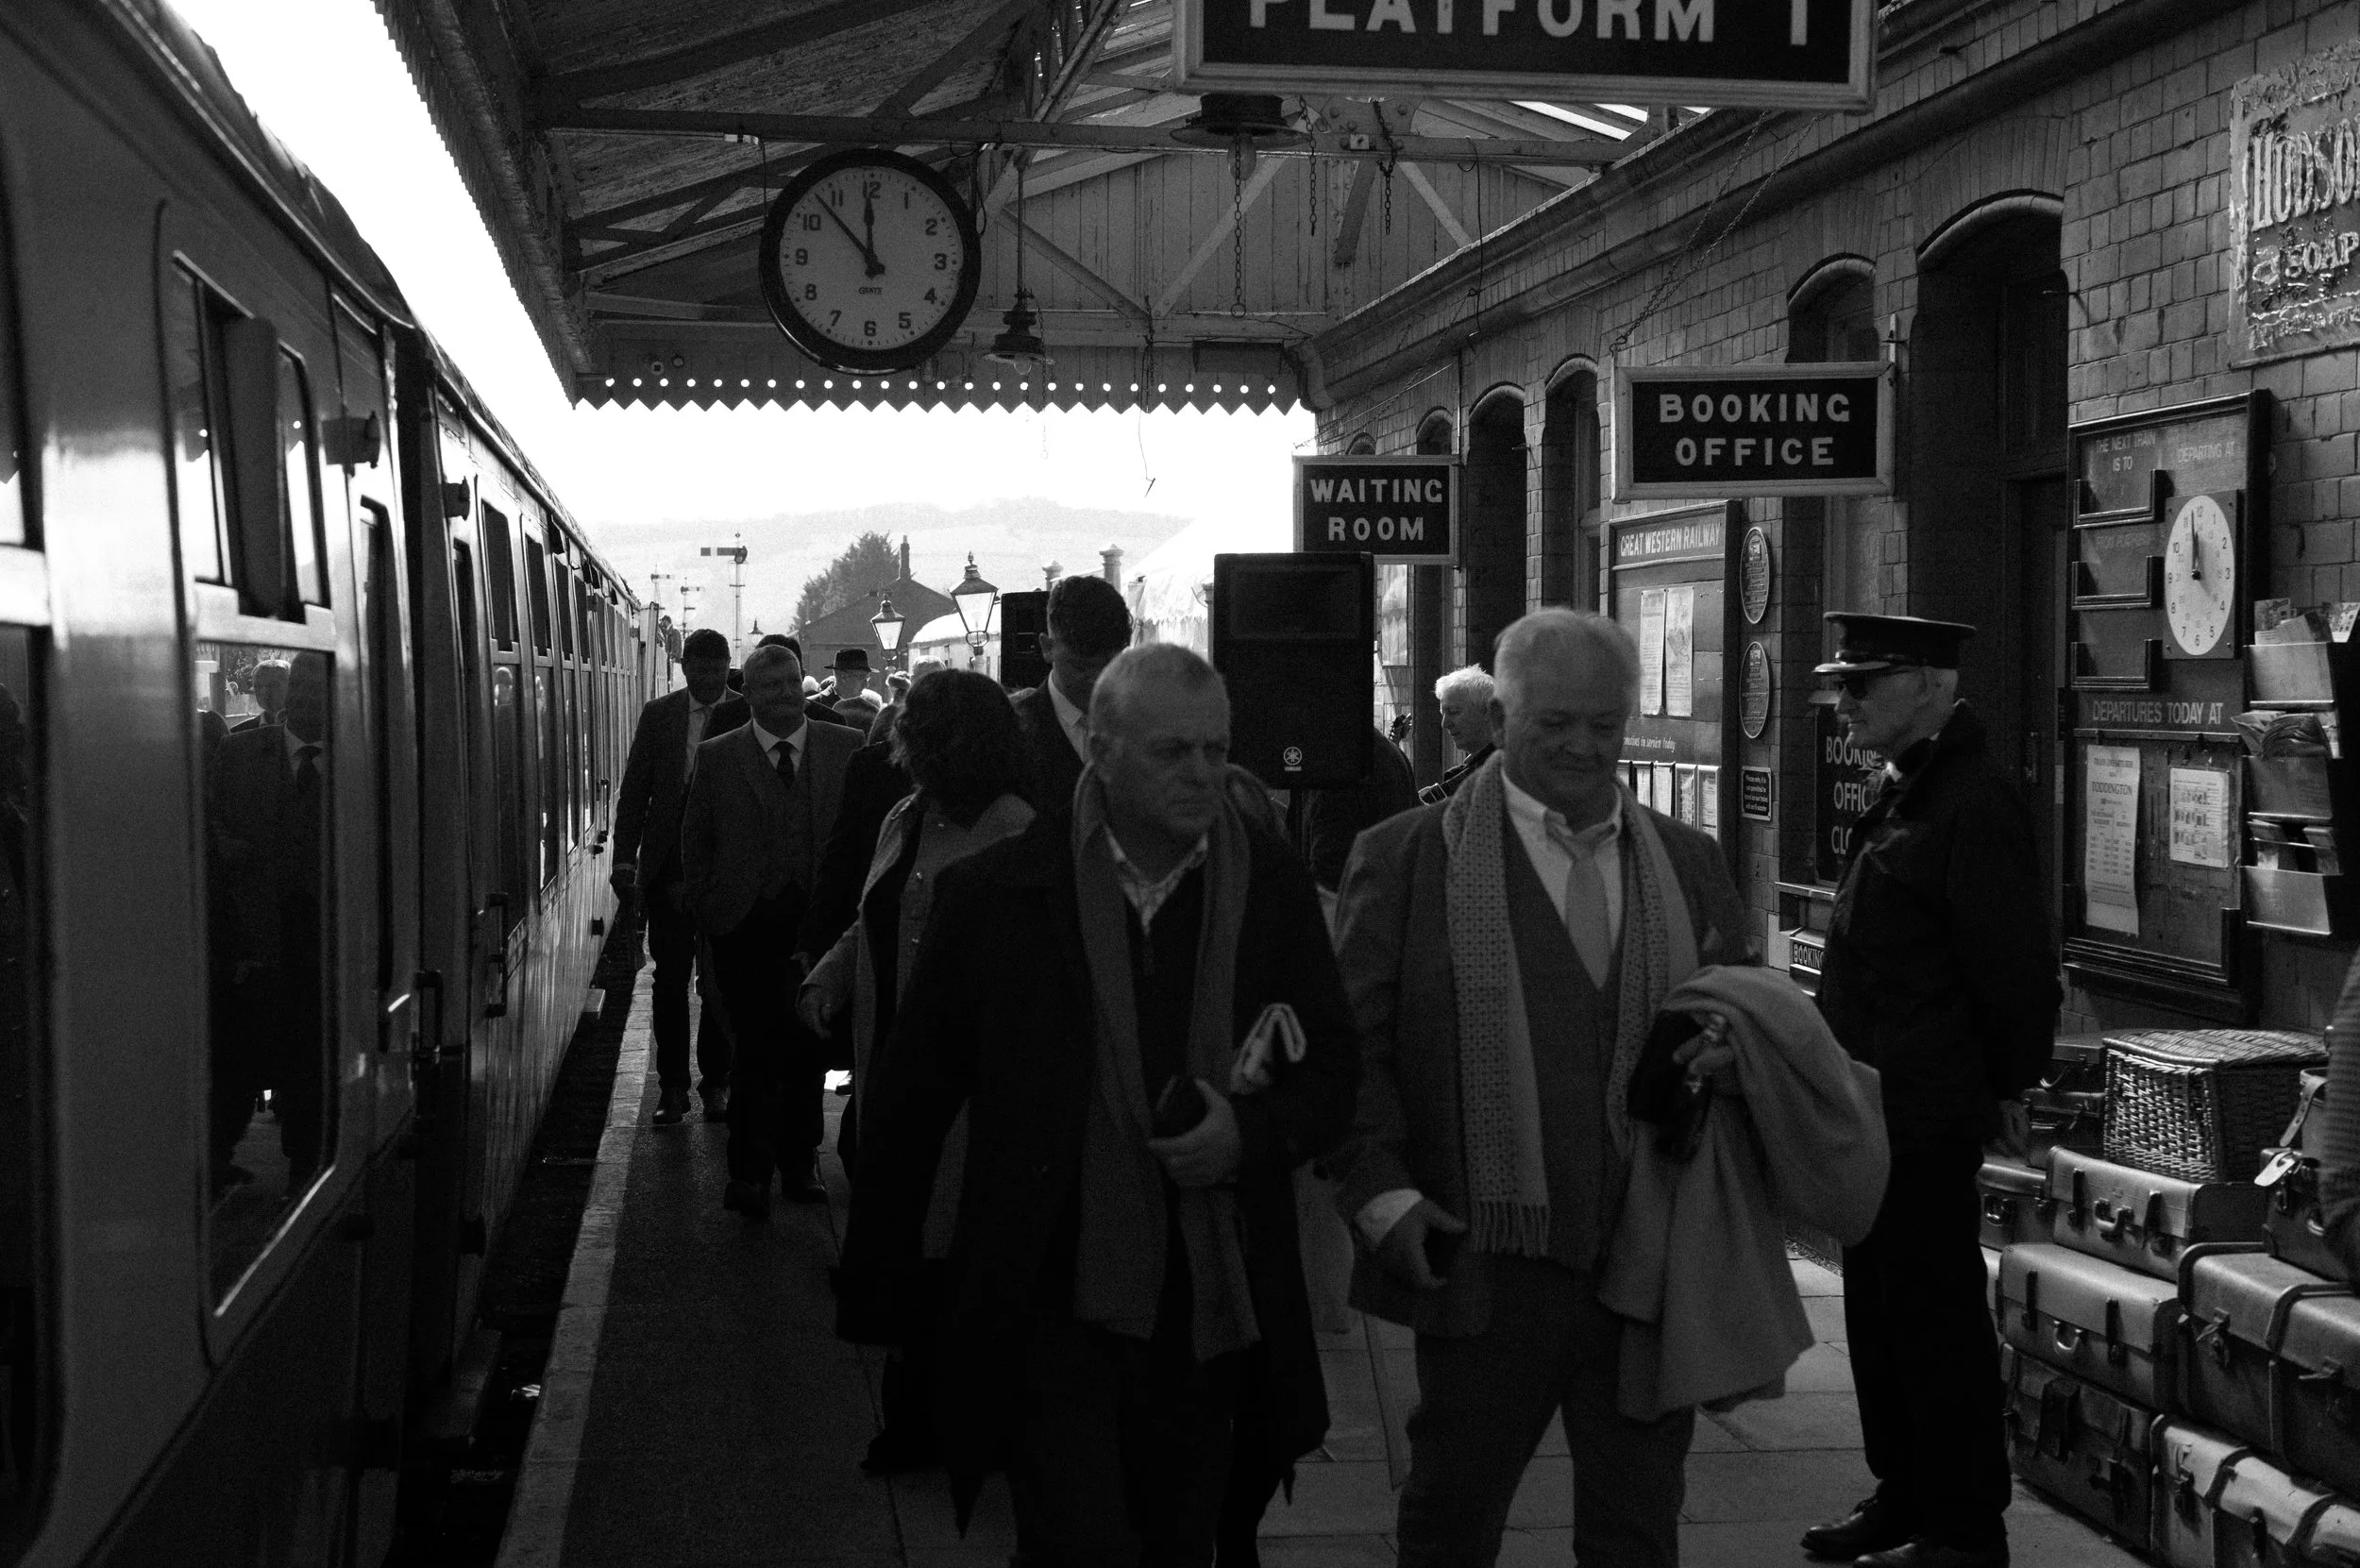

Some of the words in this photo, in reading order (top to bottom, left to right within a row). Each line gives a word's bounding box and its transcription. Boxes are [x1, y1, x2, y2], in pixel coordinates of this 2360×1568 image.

[832, 190, 843, 207] 11
[863, 180, 882, 199] 12
[802, 213, 821, 231] 10
[925, 218, 938, 236] 2
[795, 248, 809, 265] 9
[934, 253, 948, 270] 3
[804, 284, 818, 301] 8
[923, 287, 937, 305] 4
[830, 310, 842, 326] 7
[898, 312, 912, 329] 5
[864, 320, 877, 337] 6
[1659, 393, 1850, 423] BOOKING
[1675, 436, 1834, 466] OFFICE
[2113, 457, 2121, 472] IS
[2123, 455, 2133, 470] TO
[1310, 479, 1443, 503] WAITING
[1328, 516, 1424, 541] ROOM
[1620, 532, 1644, 557] GREAT
[1644, 528, 1682, 554] WESTERN
[1683, 522, 1721, 549] RAILWAY
[2093, 700, 2162, 723] DEPARTURES
[2166, 701, 2205, 724] TODAY
[2208, 702, 2224, 725] AT
[1833, 781, 1870, 812] OFFIC
